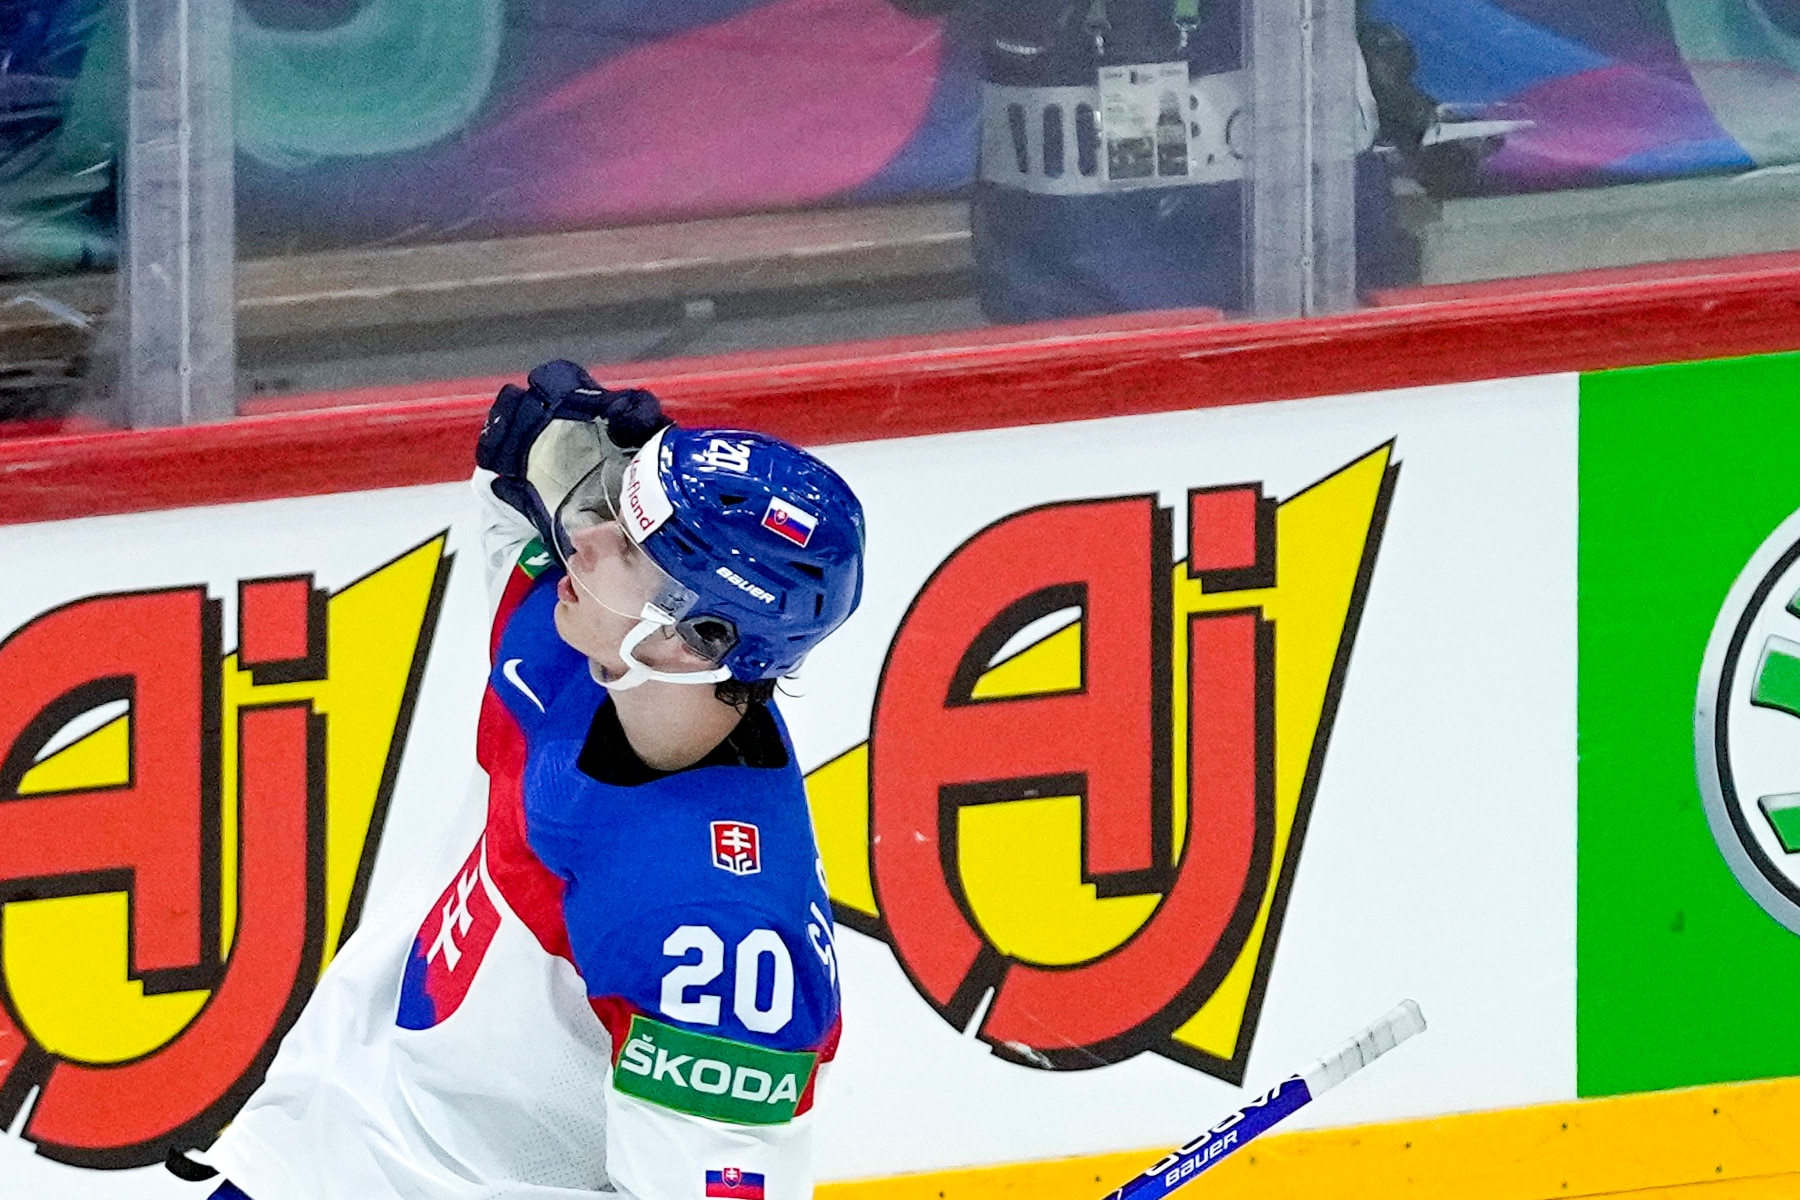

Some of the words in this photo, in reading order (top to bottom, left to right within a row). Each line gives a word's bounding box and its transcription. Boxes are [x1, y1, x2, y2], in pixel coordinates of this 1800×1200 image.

[627, 459, 656, 532] fland
[660, 925, 795, 1034] 20
[621, 1033, 799, 1105] ŠKODA
